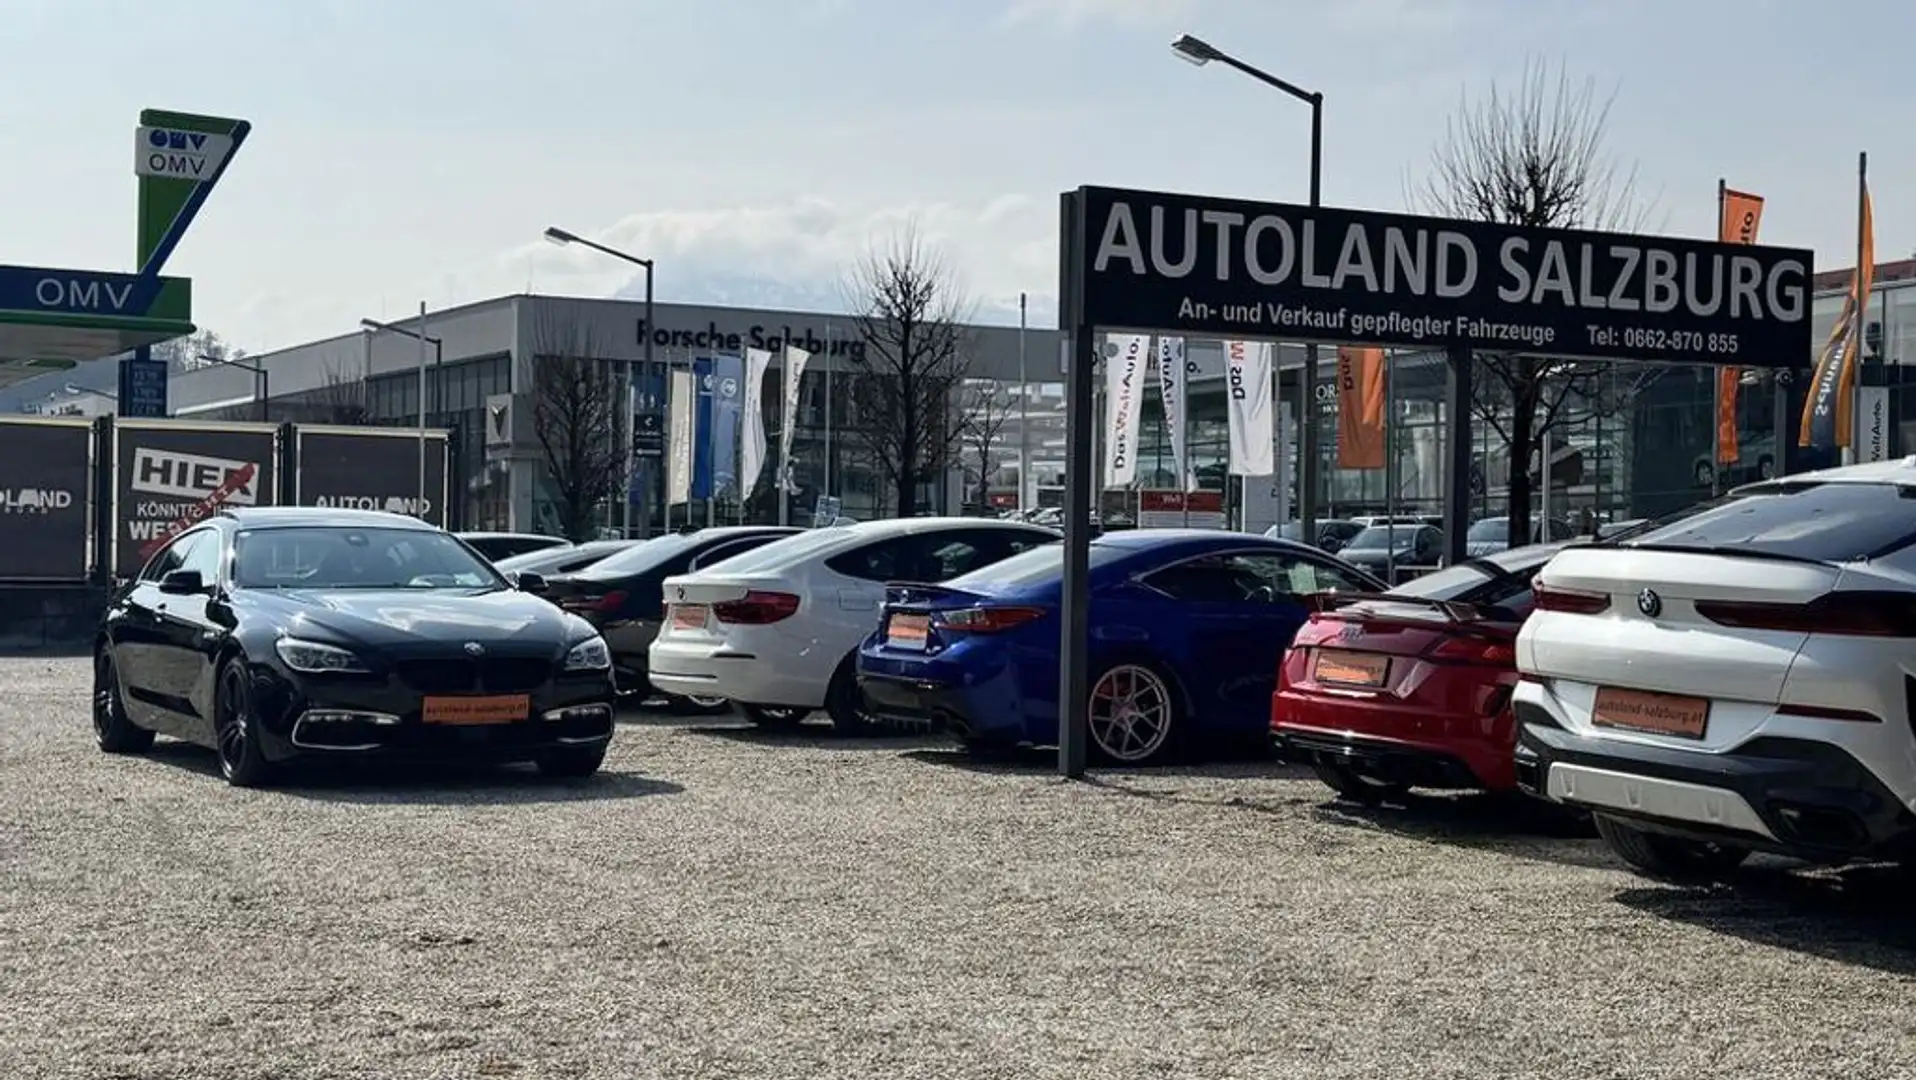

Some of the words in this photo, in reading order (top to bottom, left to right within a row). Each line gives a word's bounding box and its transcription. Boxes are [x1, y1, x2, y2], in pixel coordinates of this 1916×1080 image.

[150, 153, 206, 174] OMV
[1094, 202, 1478, 297] AUTOLAND
[1497, 236, 1805, 322] SALZBURG
[36, 278, 133, 309] OMV
[749, 325, 867, 362] Salzburg
[1178, 297, 1217, 319] An-
[1223, 302, 1262, 325] und
[1268, 304, 1347, 329] Verkauf
[1351, 311, 1452, 339] gepflegter
[1456, 316, 1555, 346] Fahrzeuge
[1587, 325, 1619, 346] Tel:
[1624, 327, 1703, 351] 0662-870
[1708, 333, 1738, 353] 855
[140, 456, 252, 497] HIER
